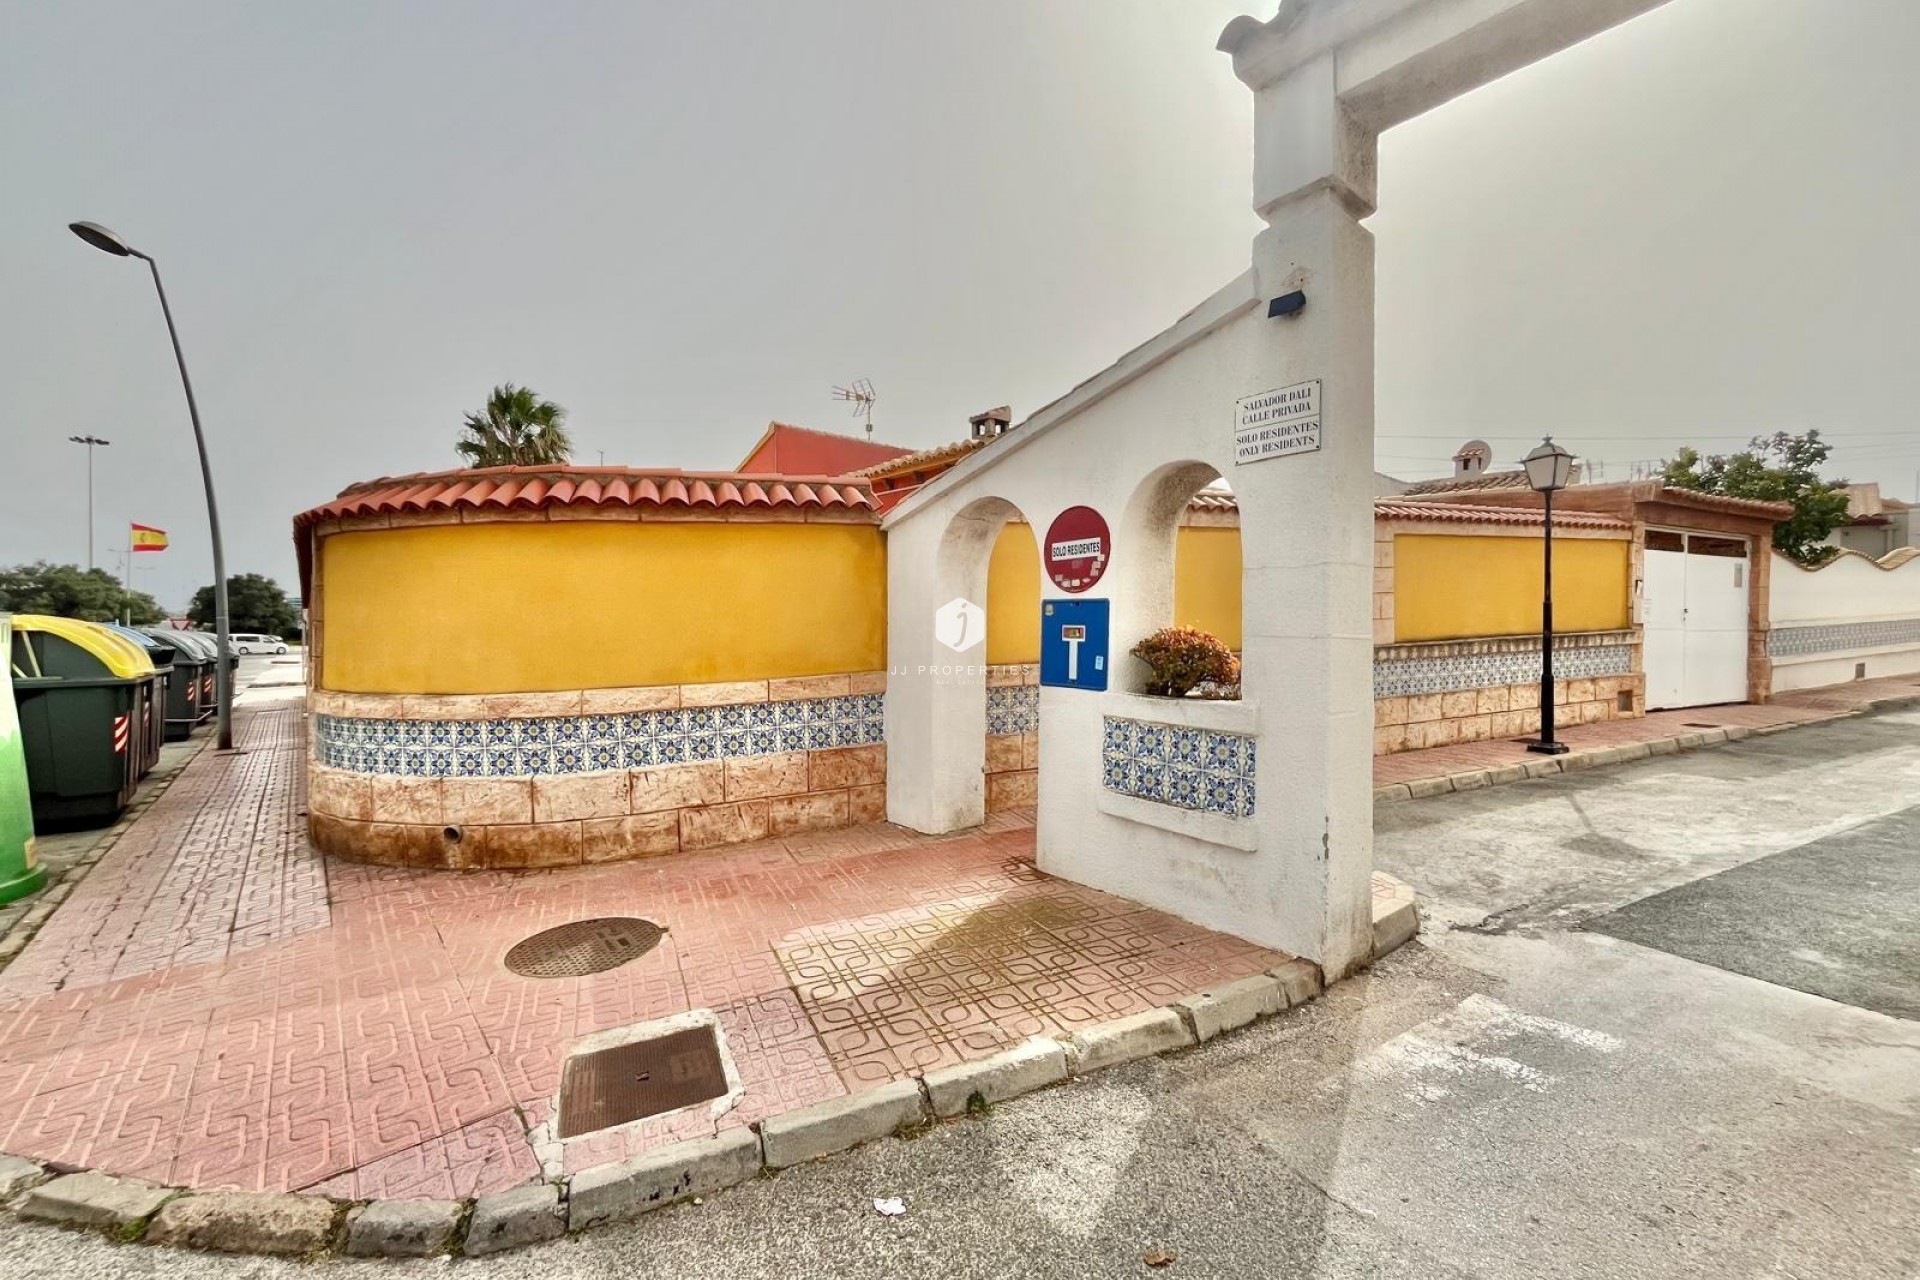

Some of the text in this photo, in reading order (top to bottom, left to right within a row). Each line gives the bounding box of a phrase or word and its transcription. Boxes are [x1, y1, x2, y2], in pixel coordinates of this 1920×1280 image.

[1244, 387, 1311, 411] SALVADOR DALI
[1242, 401, 1311, 425] CALLE PRIVADA
[1236, 420, 1319, 445] SOLO RESIDENTES
[1239, 435, 1315, 457] ONLY RESIDENTS
[1053, 541, 1100, 557] SOLO RESIDENTES
